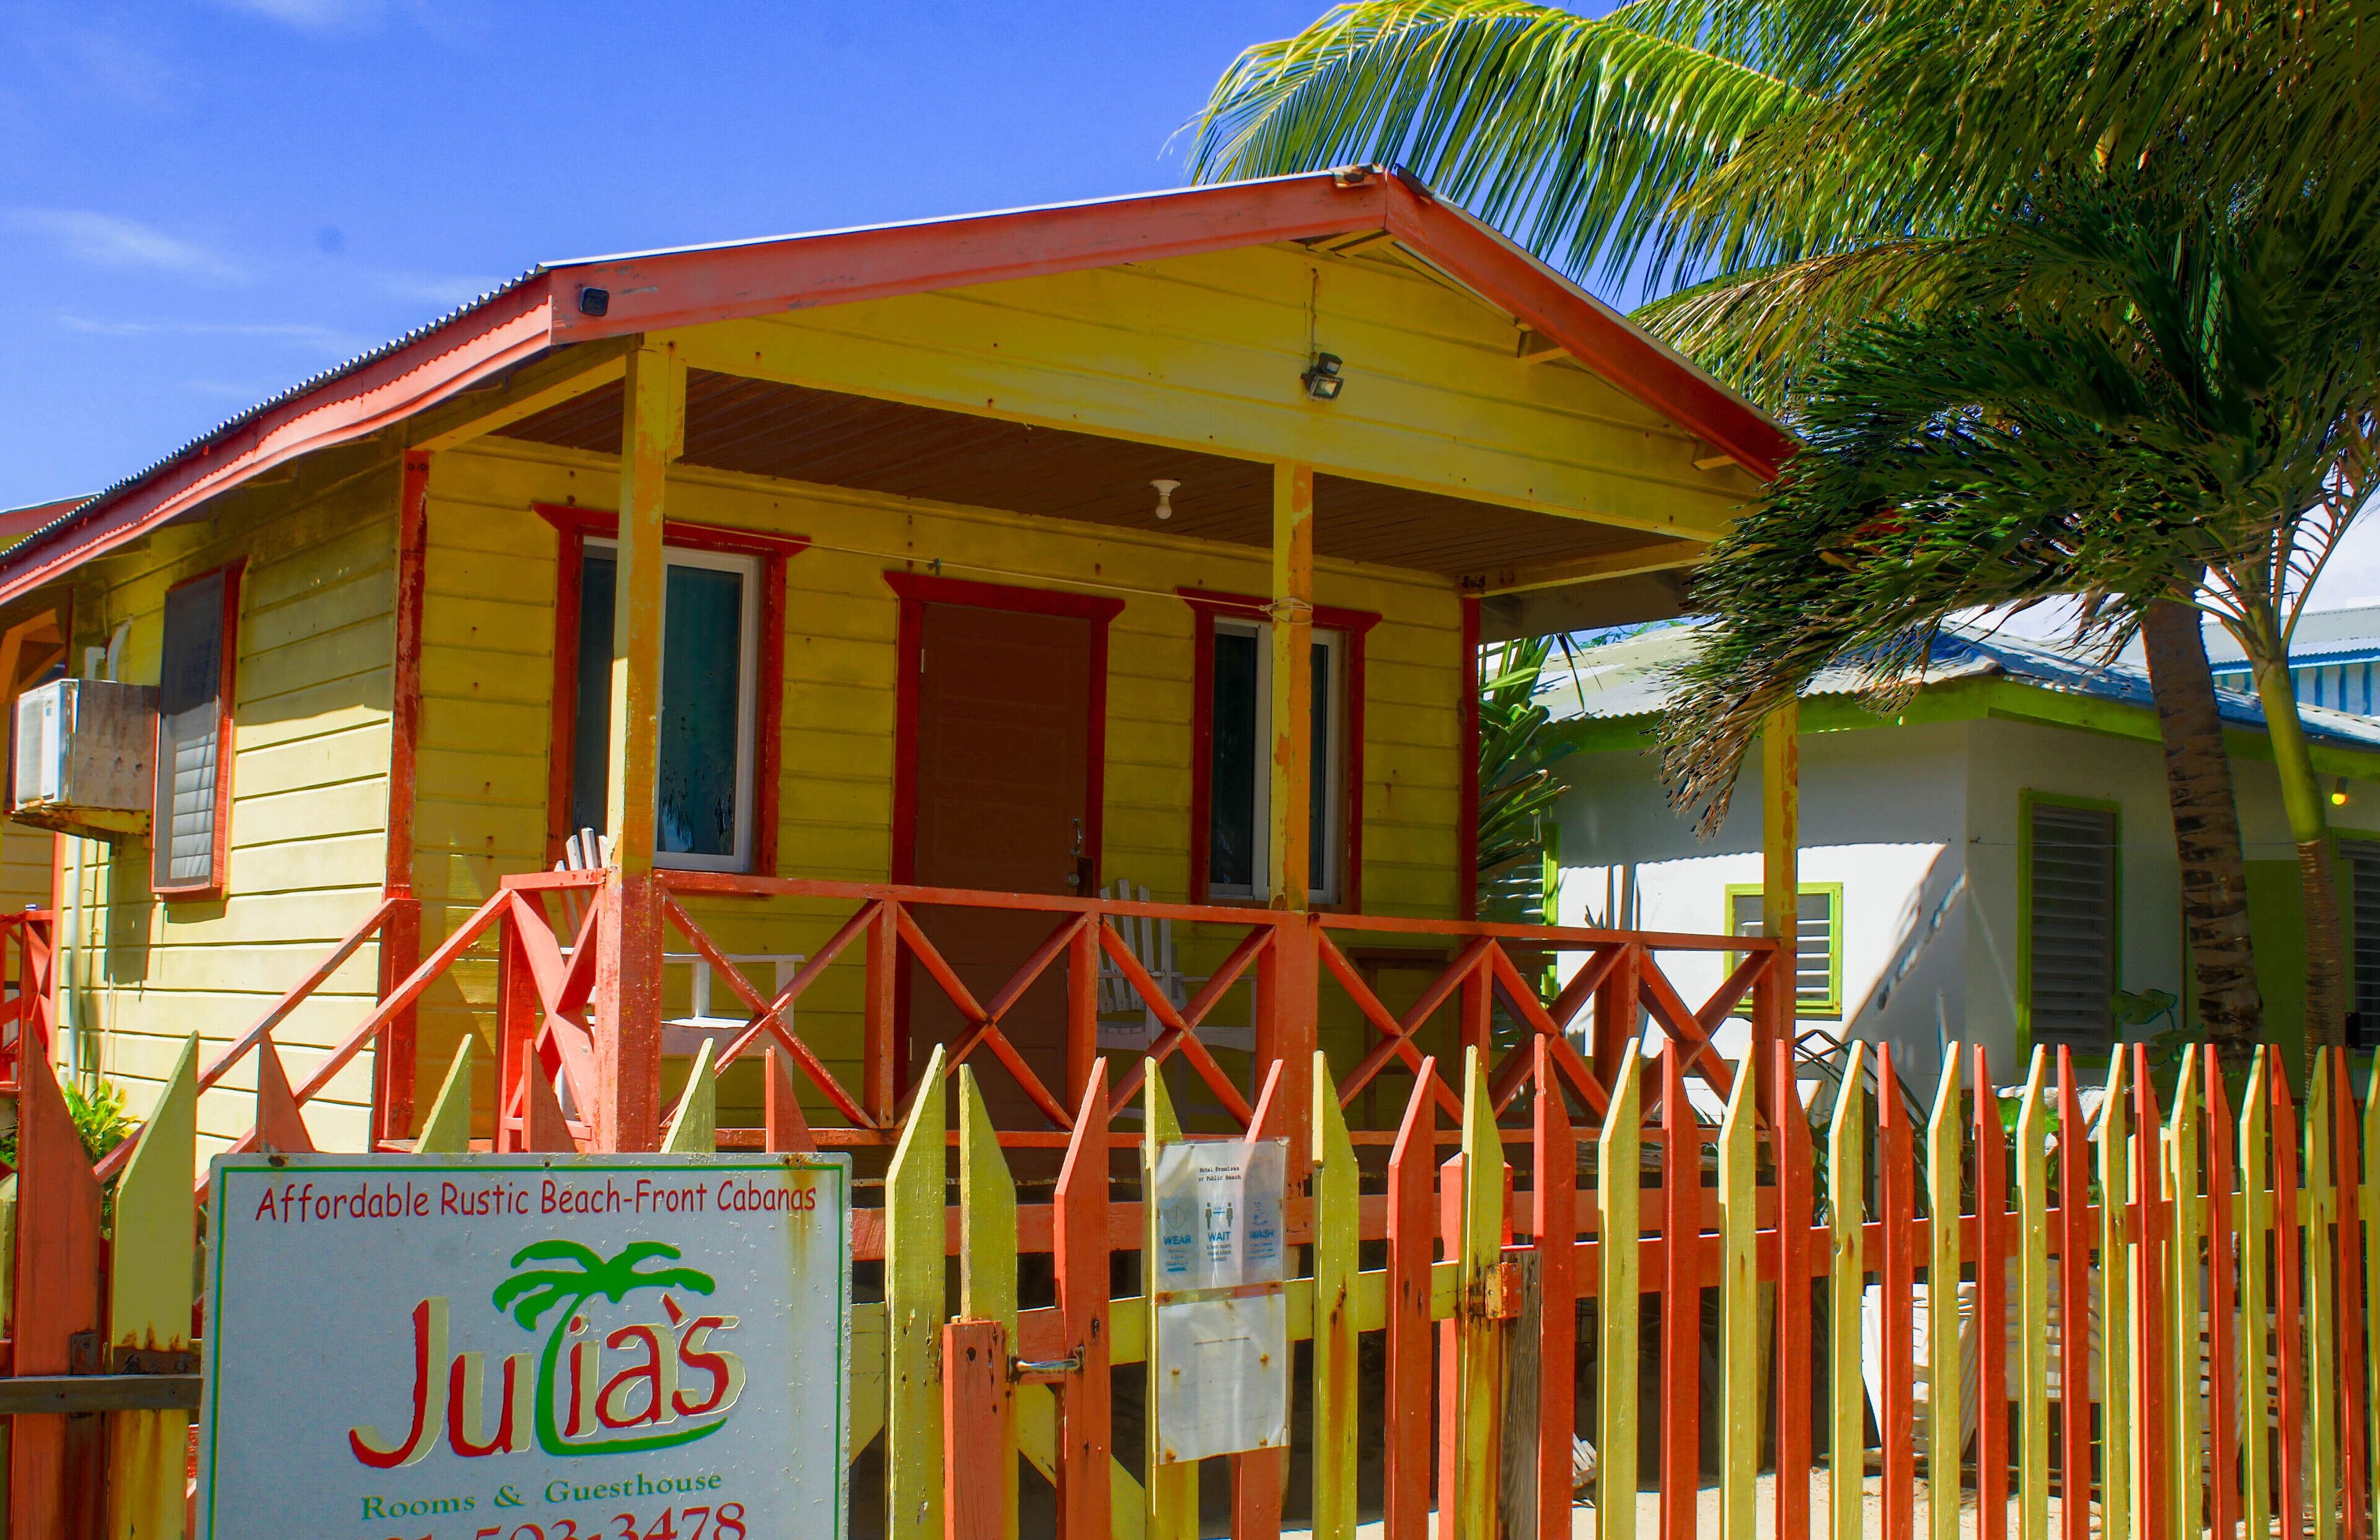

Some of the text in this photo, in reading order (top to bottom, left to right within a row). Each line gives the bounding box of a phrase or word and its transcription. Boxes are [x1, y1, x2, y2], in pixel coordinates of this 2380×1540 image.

[255, 1179, 817, 1223] Affordable Rustic Beach-Front Cabanas
[1163, 1234, 1191, 1245] WEAR
[1207, 1231, 1231, 1241] WAIT
[349, 1293, 746, 1470] Julia's
[361, 1471, 723, 1520] Rooms & Guesthouse
